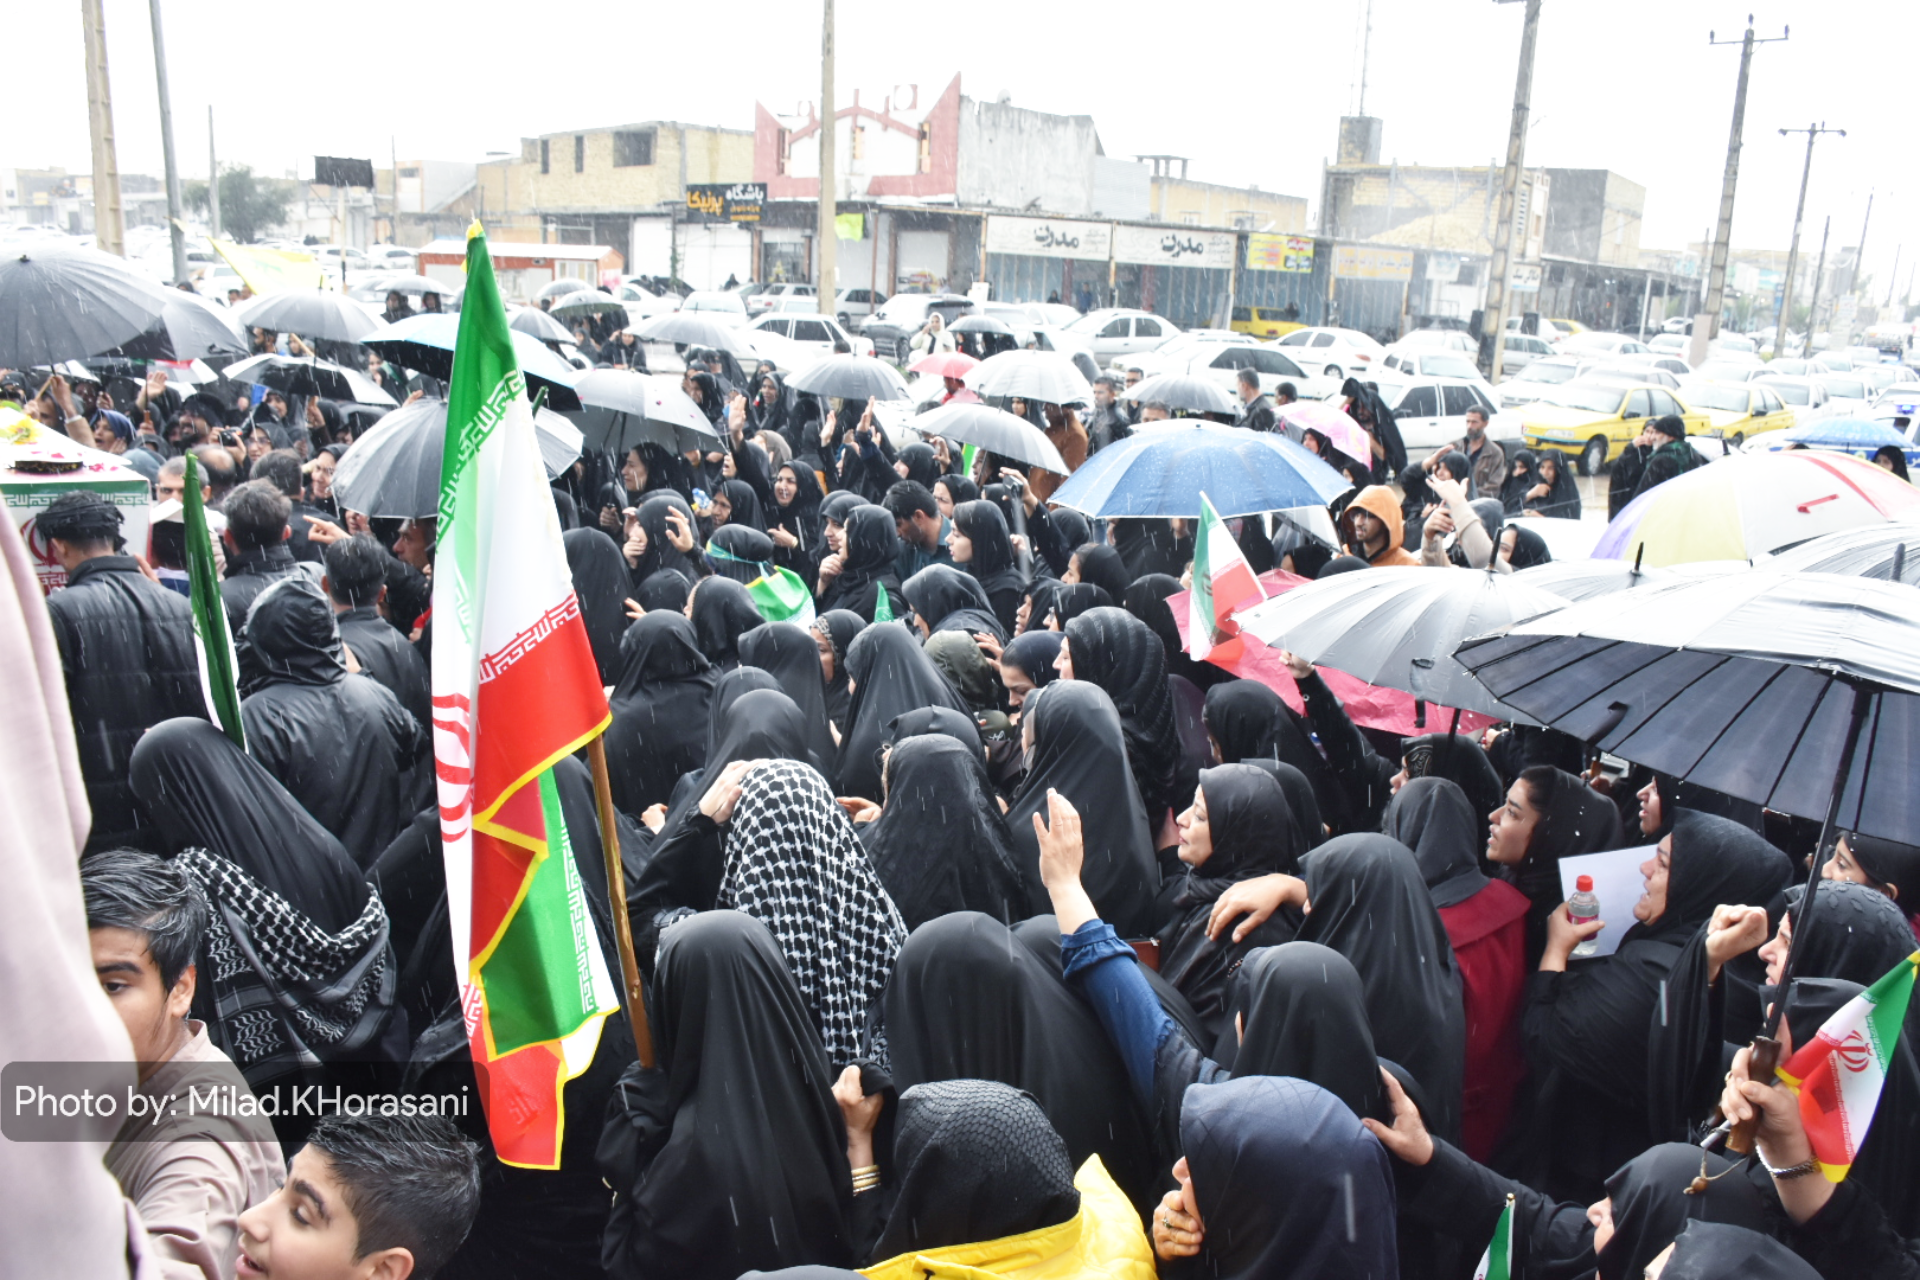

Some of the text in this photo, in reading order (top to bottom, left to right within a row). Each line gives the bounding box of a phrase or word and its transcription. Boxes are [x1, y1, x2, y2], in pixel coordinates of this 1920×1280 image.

[725, 183, 764, 205] باشگاه
[1034, 225, 1079, 248] مدرن
[1161, 234, 1203, 258] مدرن
